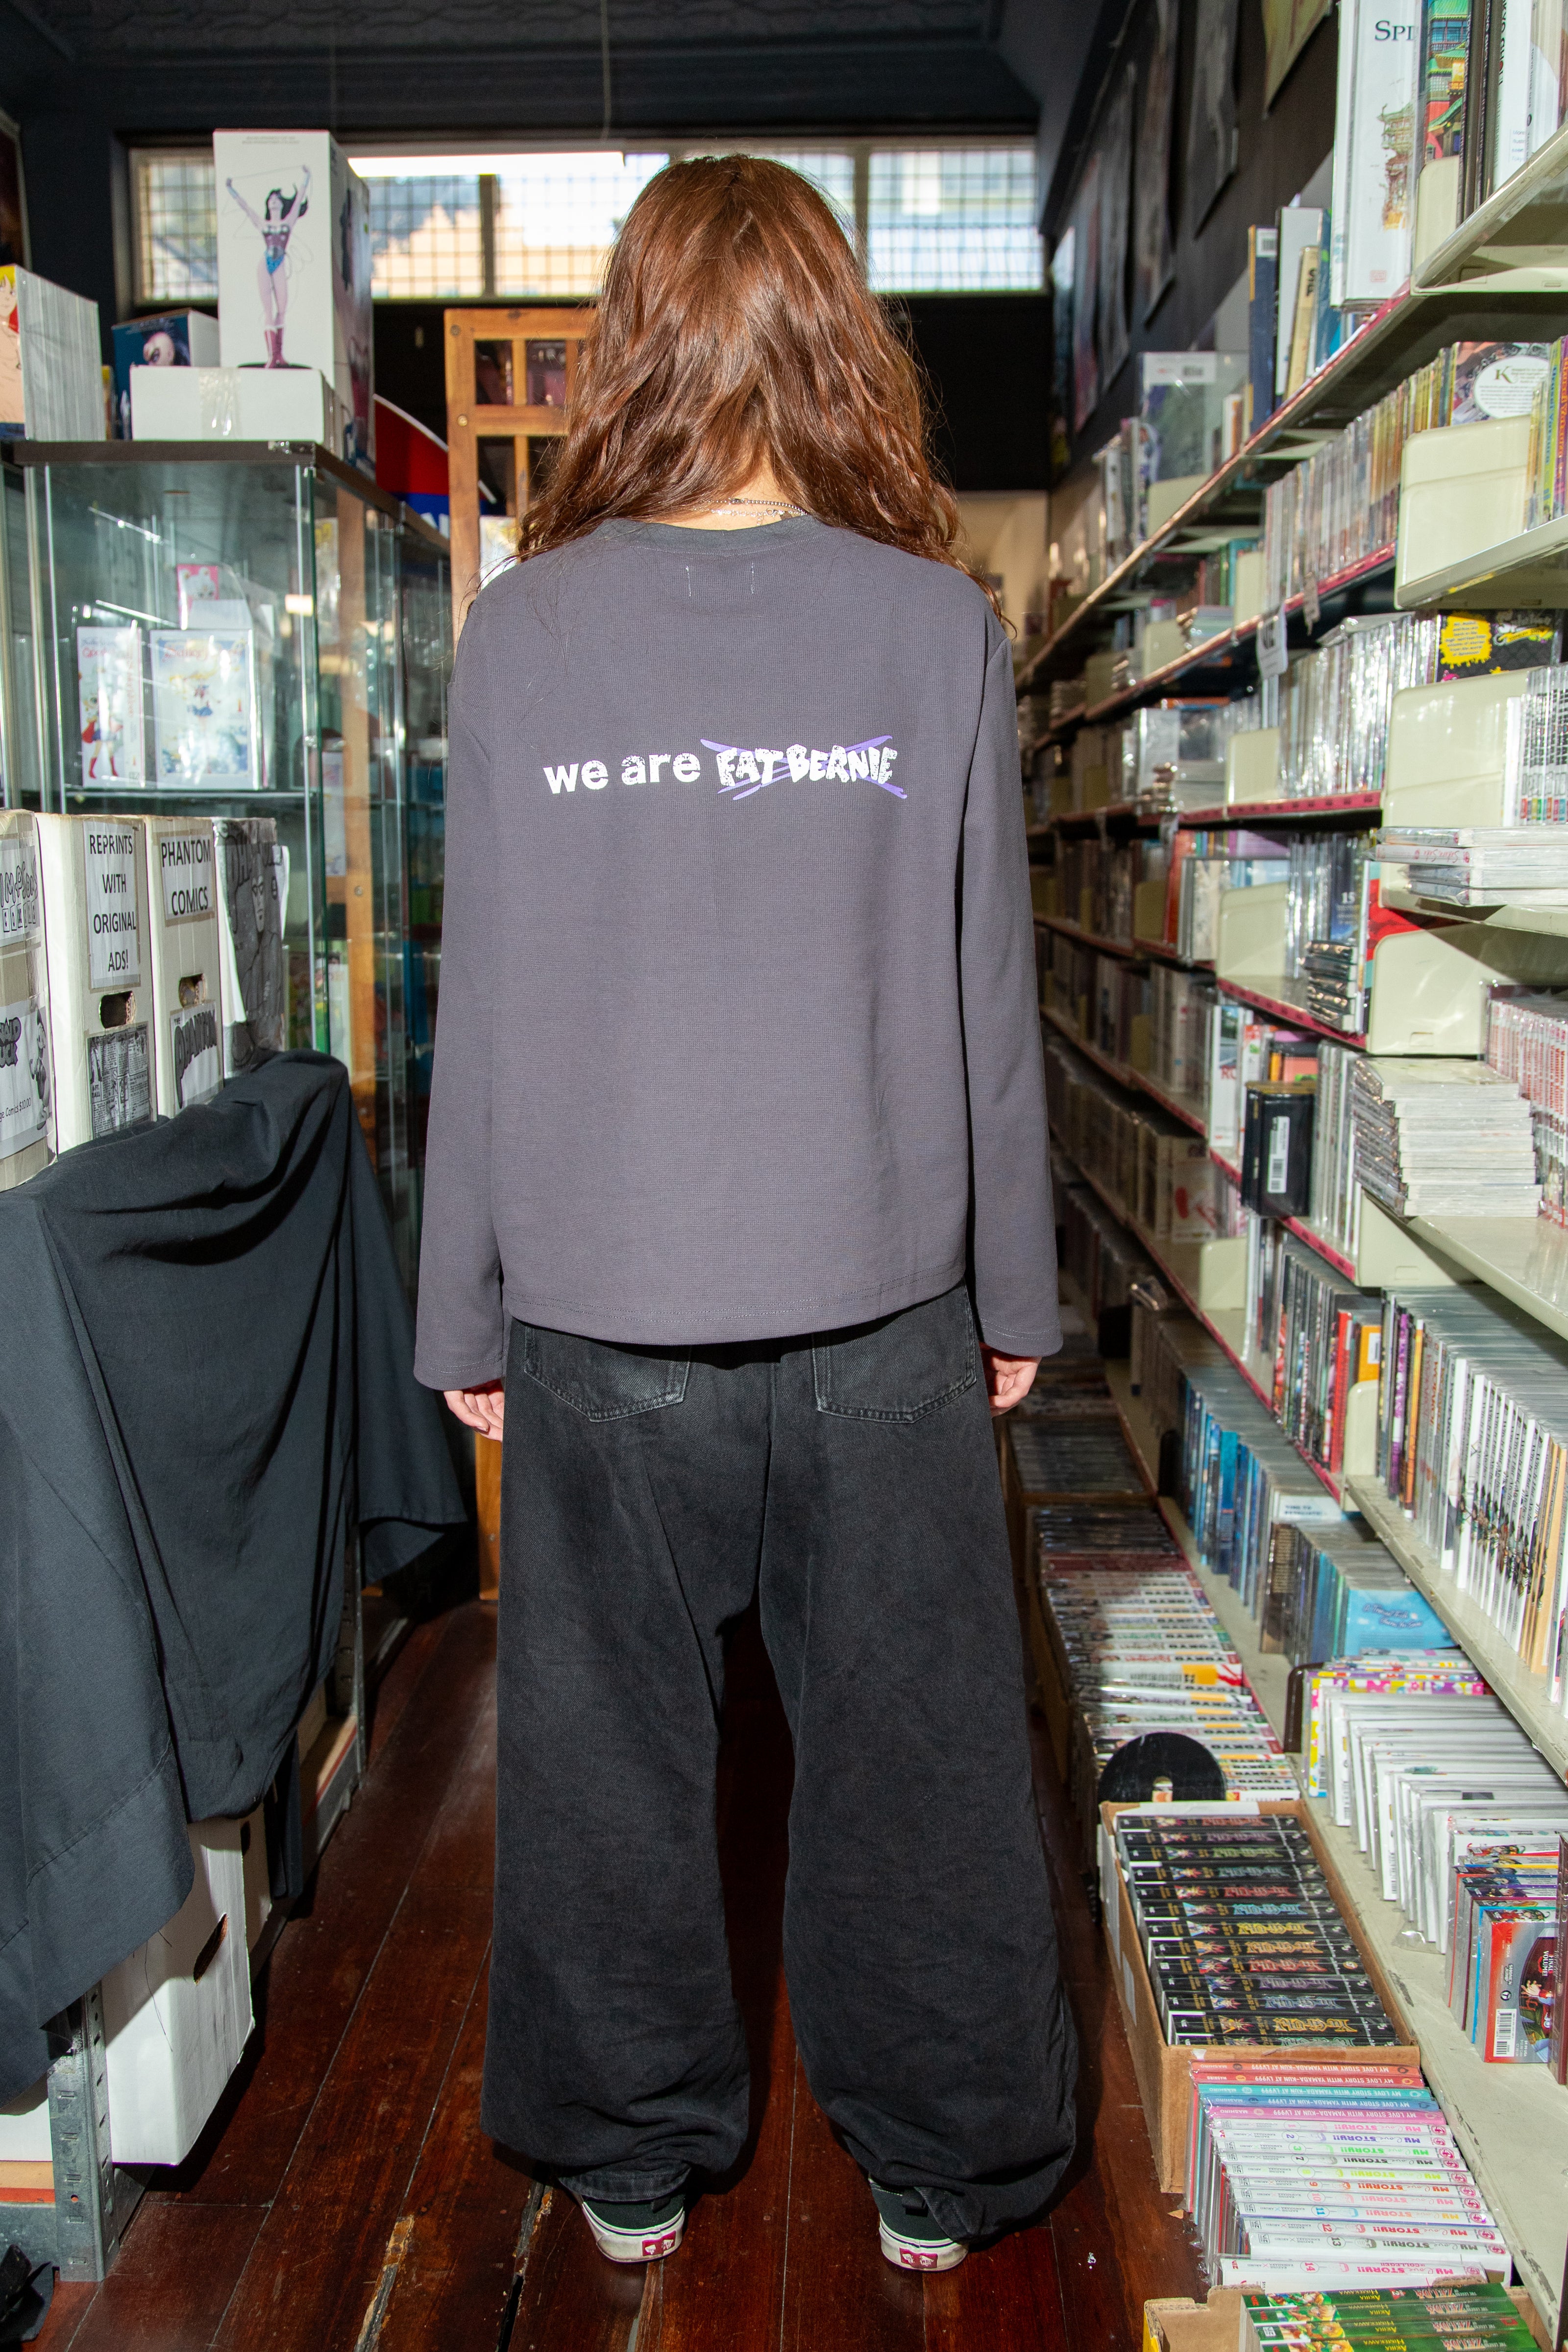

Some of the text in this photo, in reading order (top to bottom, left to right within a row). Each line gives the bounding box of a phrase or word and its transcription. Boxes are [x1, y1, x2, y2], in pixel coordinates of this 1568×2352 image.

[543, 744, 898, 794] we are FAT BERNIE
[90, 834, 133, 855] REPRINTS
[161, 839, 211, 867] PHANTOM
[102, 874, 126, 893] WITH
[172, 886, 208, 915] COMICS
[94, 911, 136, 934] ORIGINAL
[108, 949, 128, 972] ADS!
[6, 1104, 18, 1117] Comics
[19, 1098, 31, 1114] $10.00
[1312, 2193, 1322, 2202] 10
[1316, 2206, 1325, 2215] 11
[1323, 2223, 1332, 2232] 12
[1331, 2237, 1341, 2247] 13
[1305, 2262, 1315, 2271] 14
[1413, 2288, 1456, 2299] ZELDA
[1424, 2303, 1466, 2315] ZELDA
[1431, 2321, 1474, 2332] ZELDA
[1441, 2337, 1485, 2351] ZELDA
